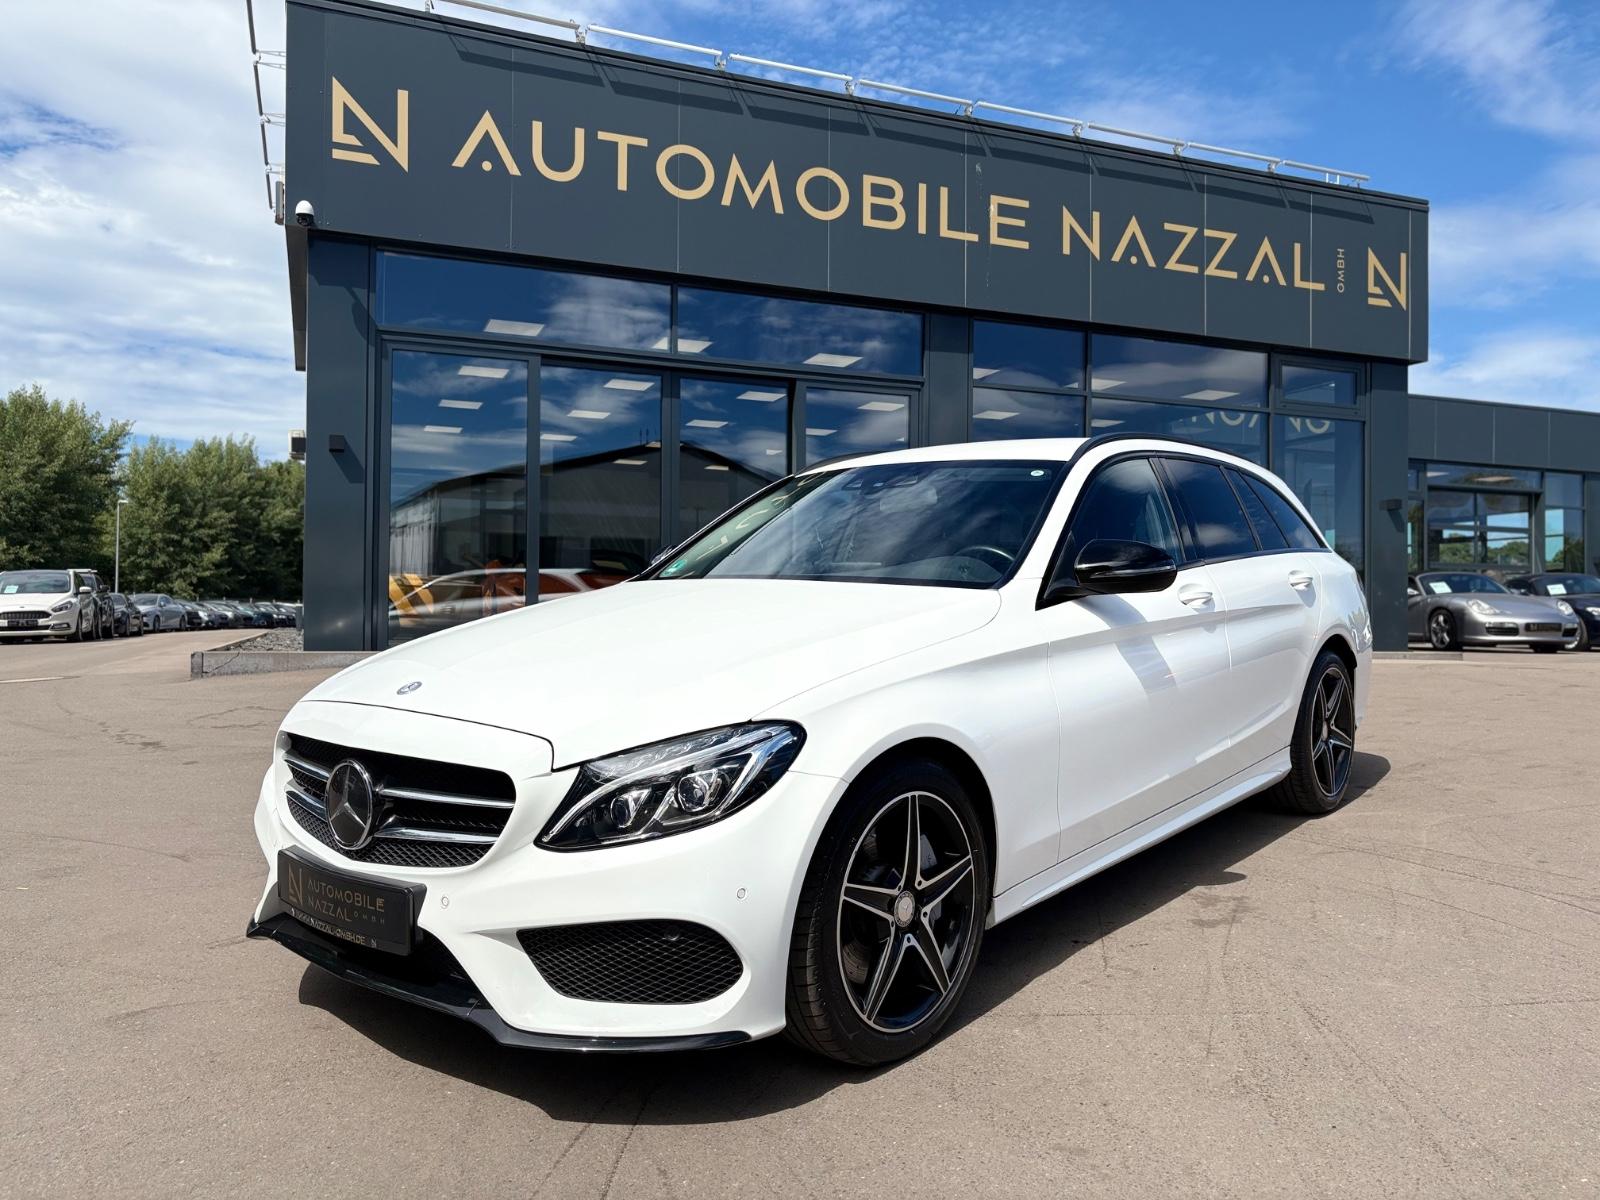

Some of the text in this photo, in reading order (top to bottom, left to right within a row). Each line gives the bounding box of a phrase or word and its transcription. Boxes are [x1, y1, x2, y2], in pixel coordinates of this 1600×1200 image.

[451, 110, 1030, 250] AUTOMOBILE
[1062, 205, 1326, 292] NAZZAL
[307, 879, 385, 913] AUTOMOBILE
[307, 895, 353, 922] NAZZAL
